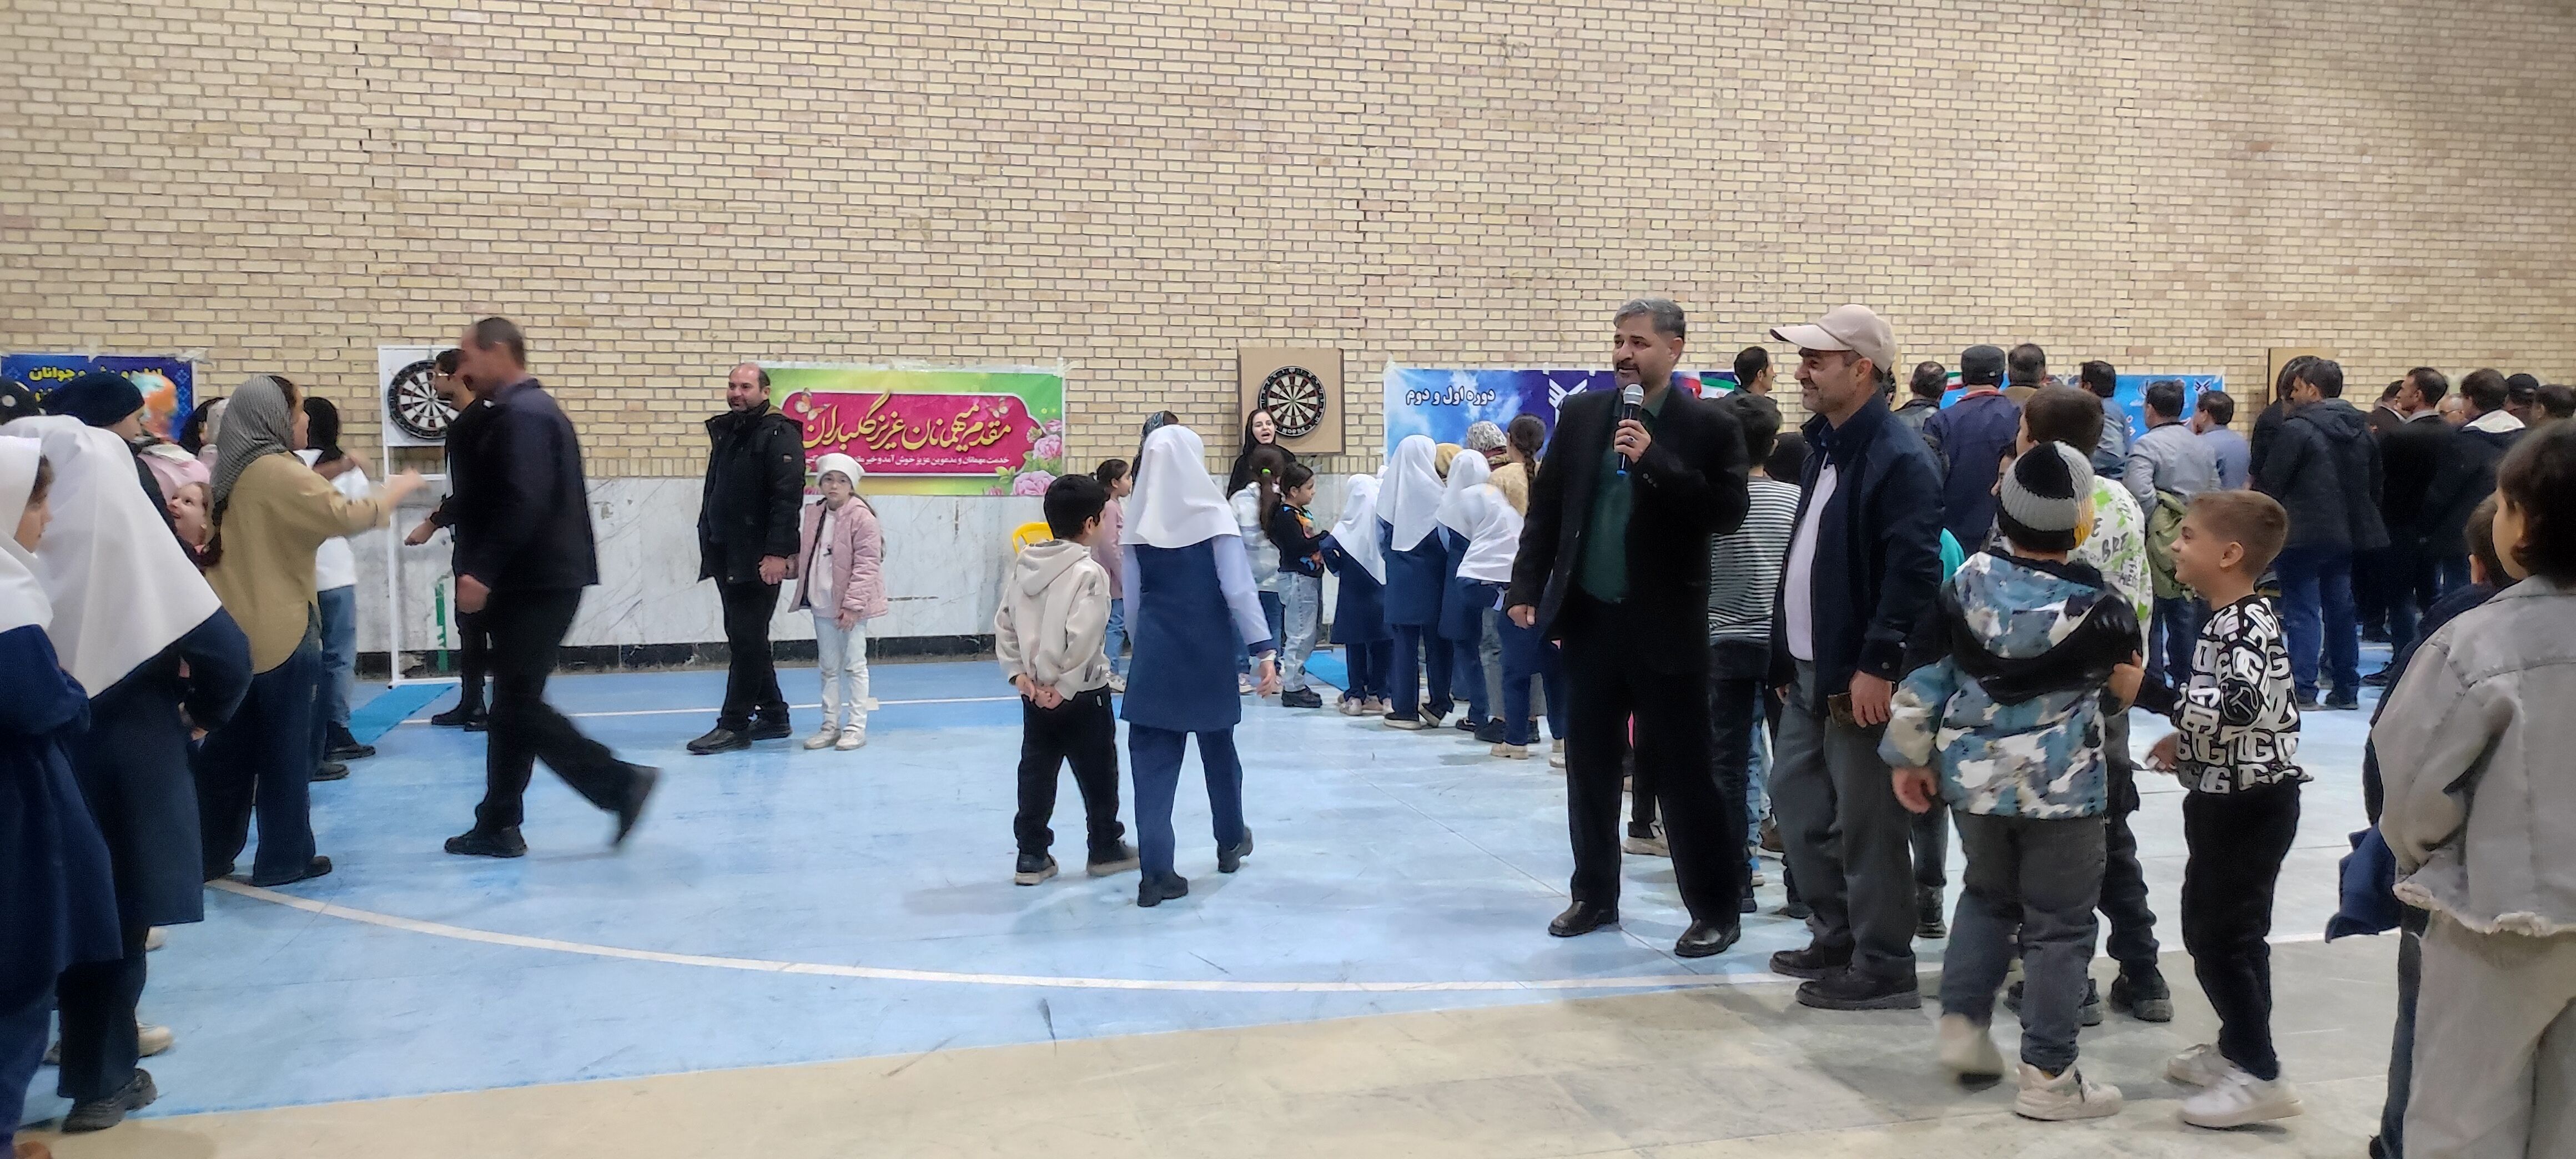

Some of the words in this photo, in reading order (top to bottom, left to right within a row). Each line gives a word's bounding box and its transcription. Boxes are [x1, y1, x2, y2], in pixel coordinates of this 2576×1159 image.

[29, 366, 76, 382] جوانان
[1406, 389, 1430, 406] دوم
[1431, 391, 1441, 406] و
[1443, 385, 1465, 406] اول
[1466, 389, 1496, 406] دوره
[802, 389, 892, 451] گلباران
[901, 404, 980, 452] میهمانان
[866, 411, 906, 450] عزیز
[961, 420, 1012, 447] مقدم
[882, 454, 895, 463] آمد
[895, 455, 915, 466] خوش
[915, 457, 930, 466] عزیز
[930, 457, 957, 466] مدعوین
[962, 456, 986, 465] مهمانان
